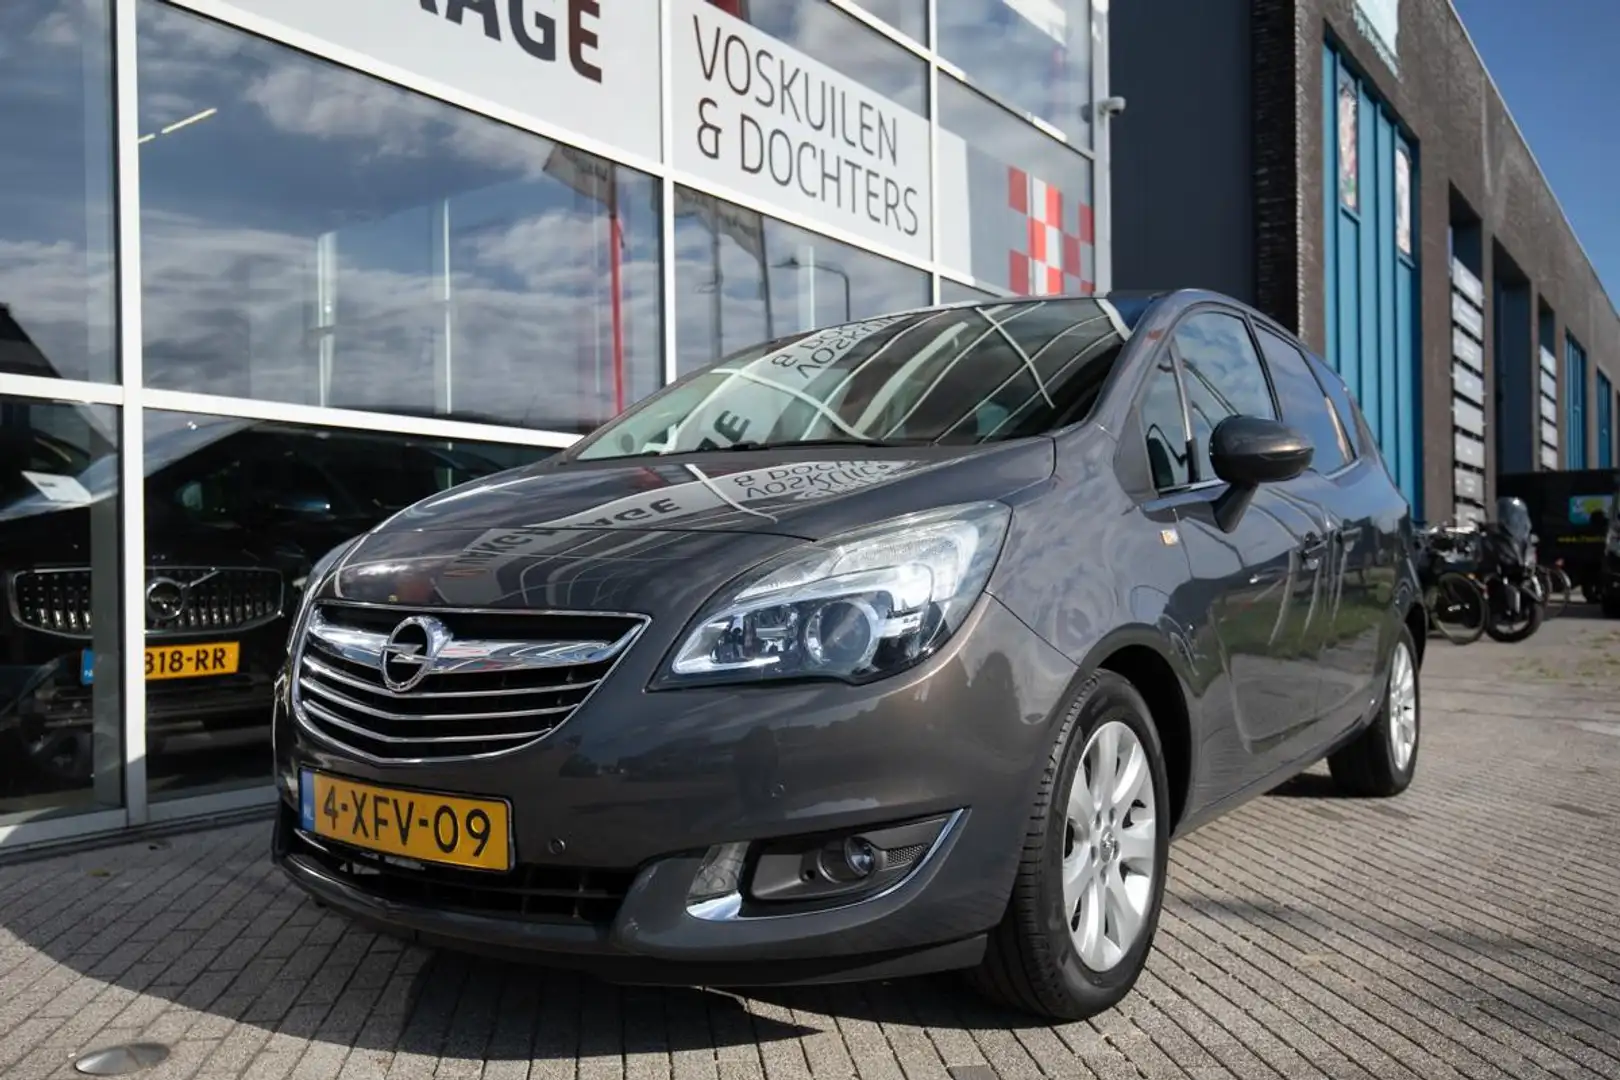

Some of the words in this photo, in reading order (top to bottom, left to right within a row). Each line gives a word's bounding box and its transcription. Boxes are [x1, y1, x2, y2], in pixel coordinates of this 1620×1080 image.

[419, 0, 602, 84] AGE
[693, 14, 898, 167] VOSKUILEN
[697, 97, 722, 160] &
[741, 112, 919, 237] DOCHTERS
[324, 785, 491, 857] 4-XFV-09
